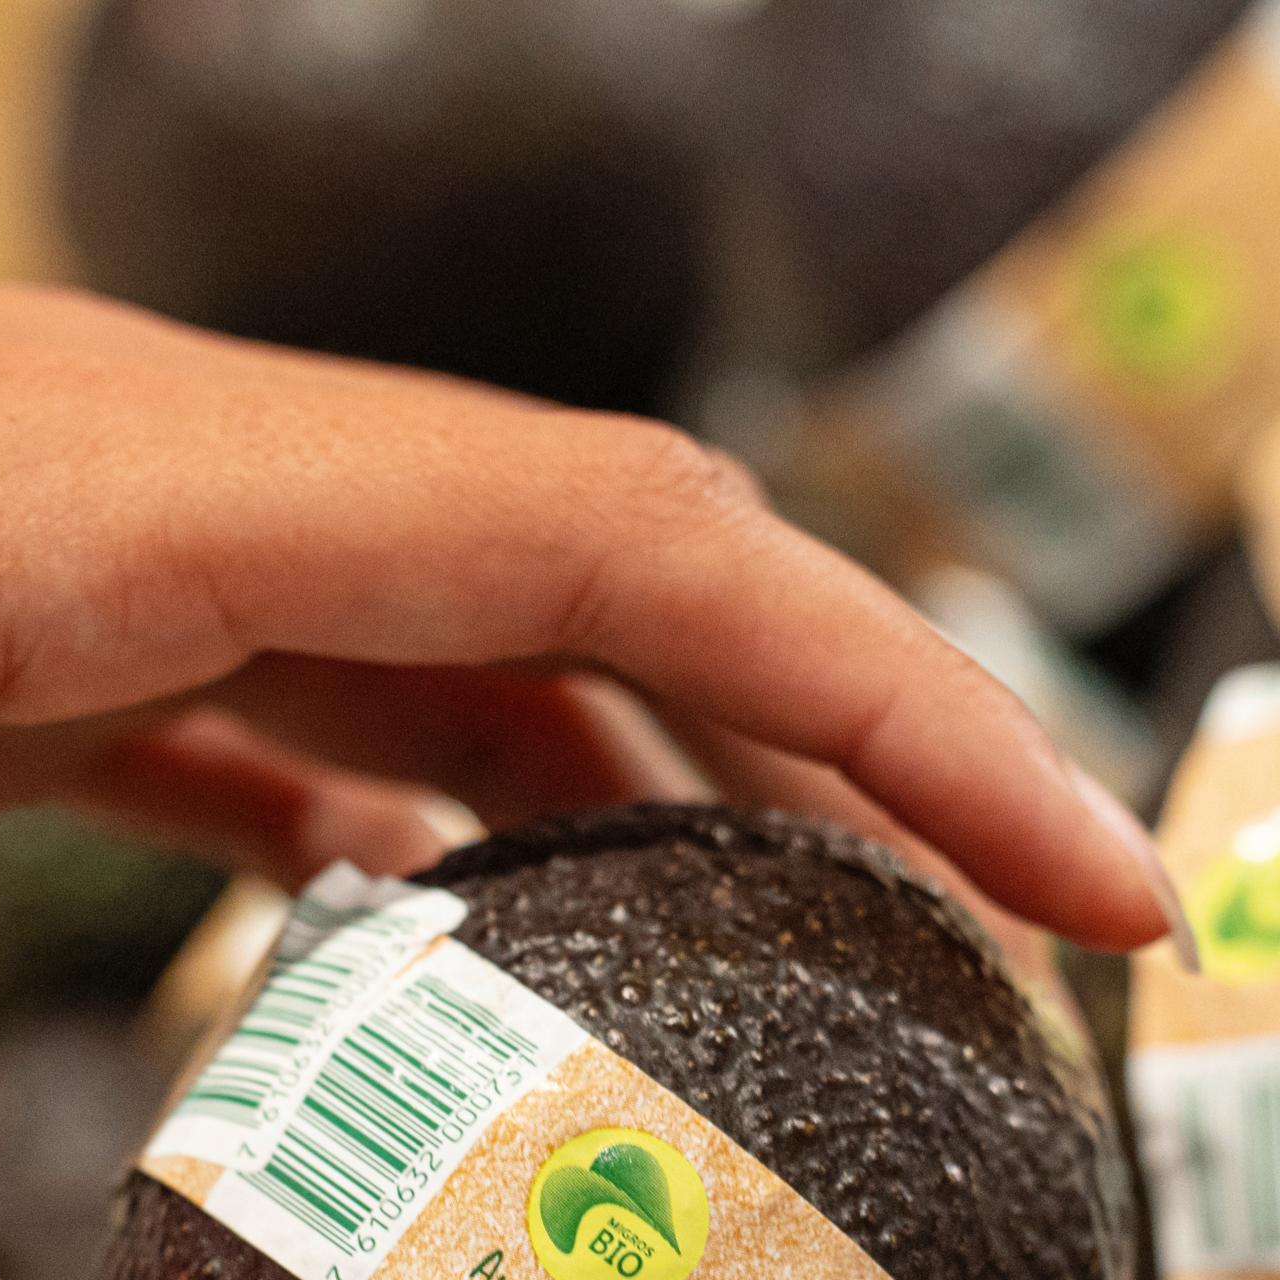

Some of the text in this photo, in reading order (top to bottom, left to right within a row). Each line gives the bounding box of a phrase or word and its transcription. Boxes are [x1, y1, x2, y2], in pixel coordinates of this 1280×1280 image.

[356, 1150, 443, 1253] 610632
[588, 1227, 645, 1279] BIO
[606, 1216, 656, 1259] MIGROS
